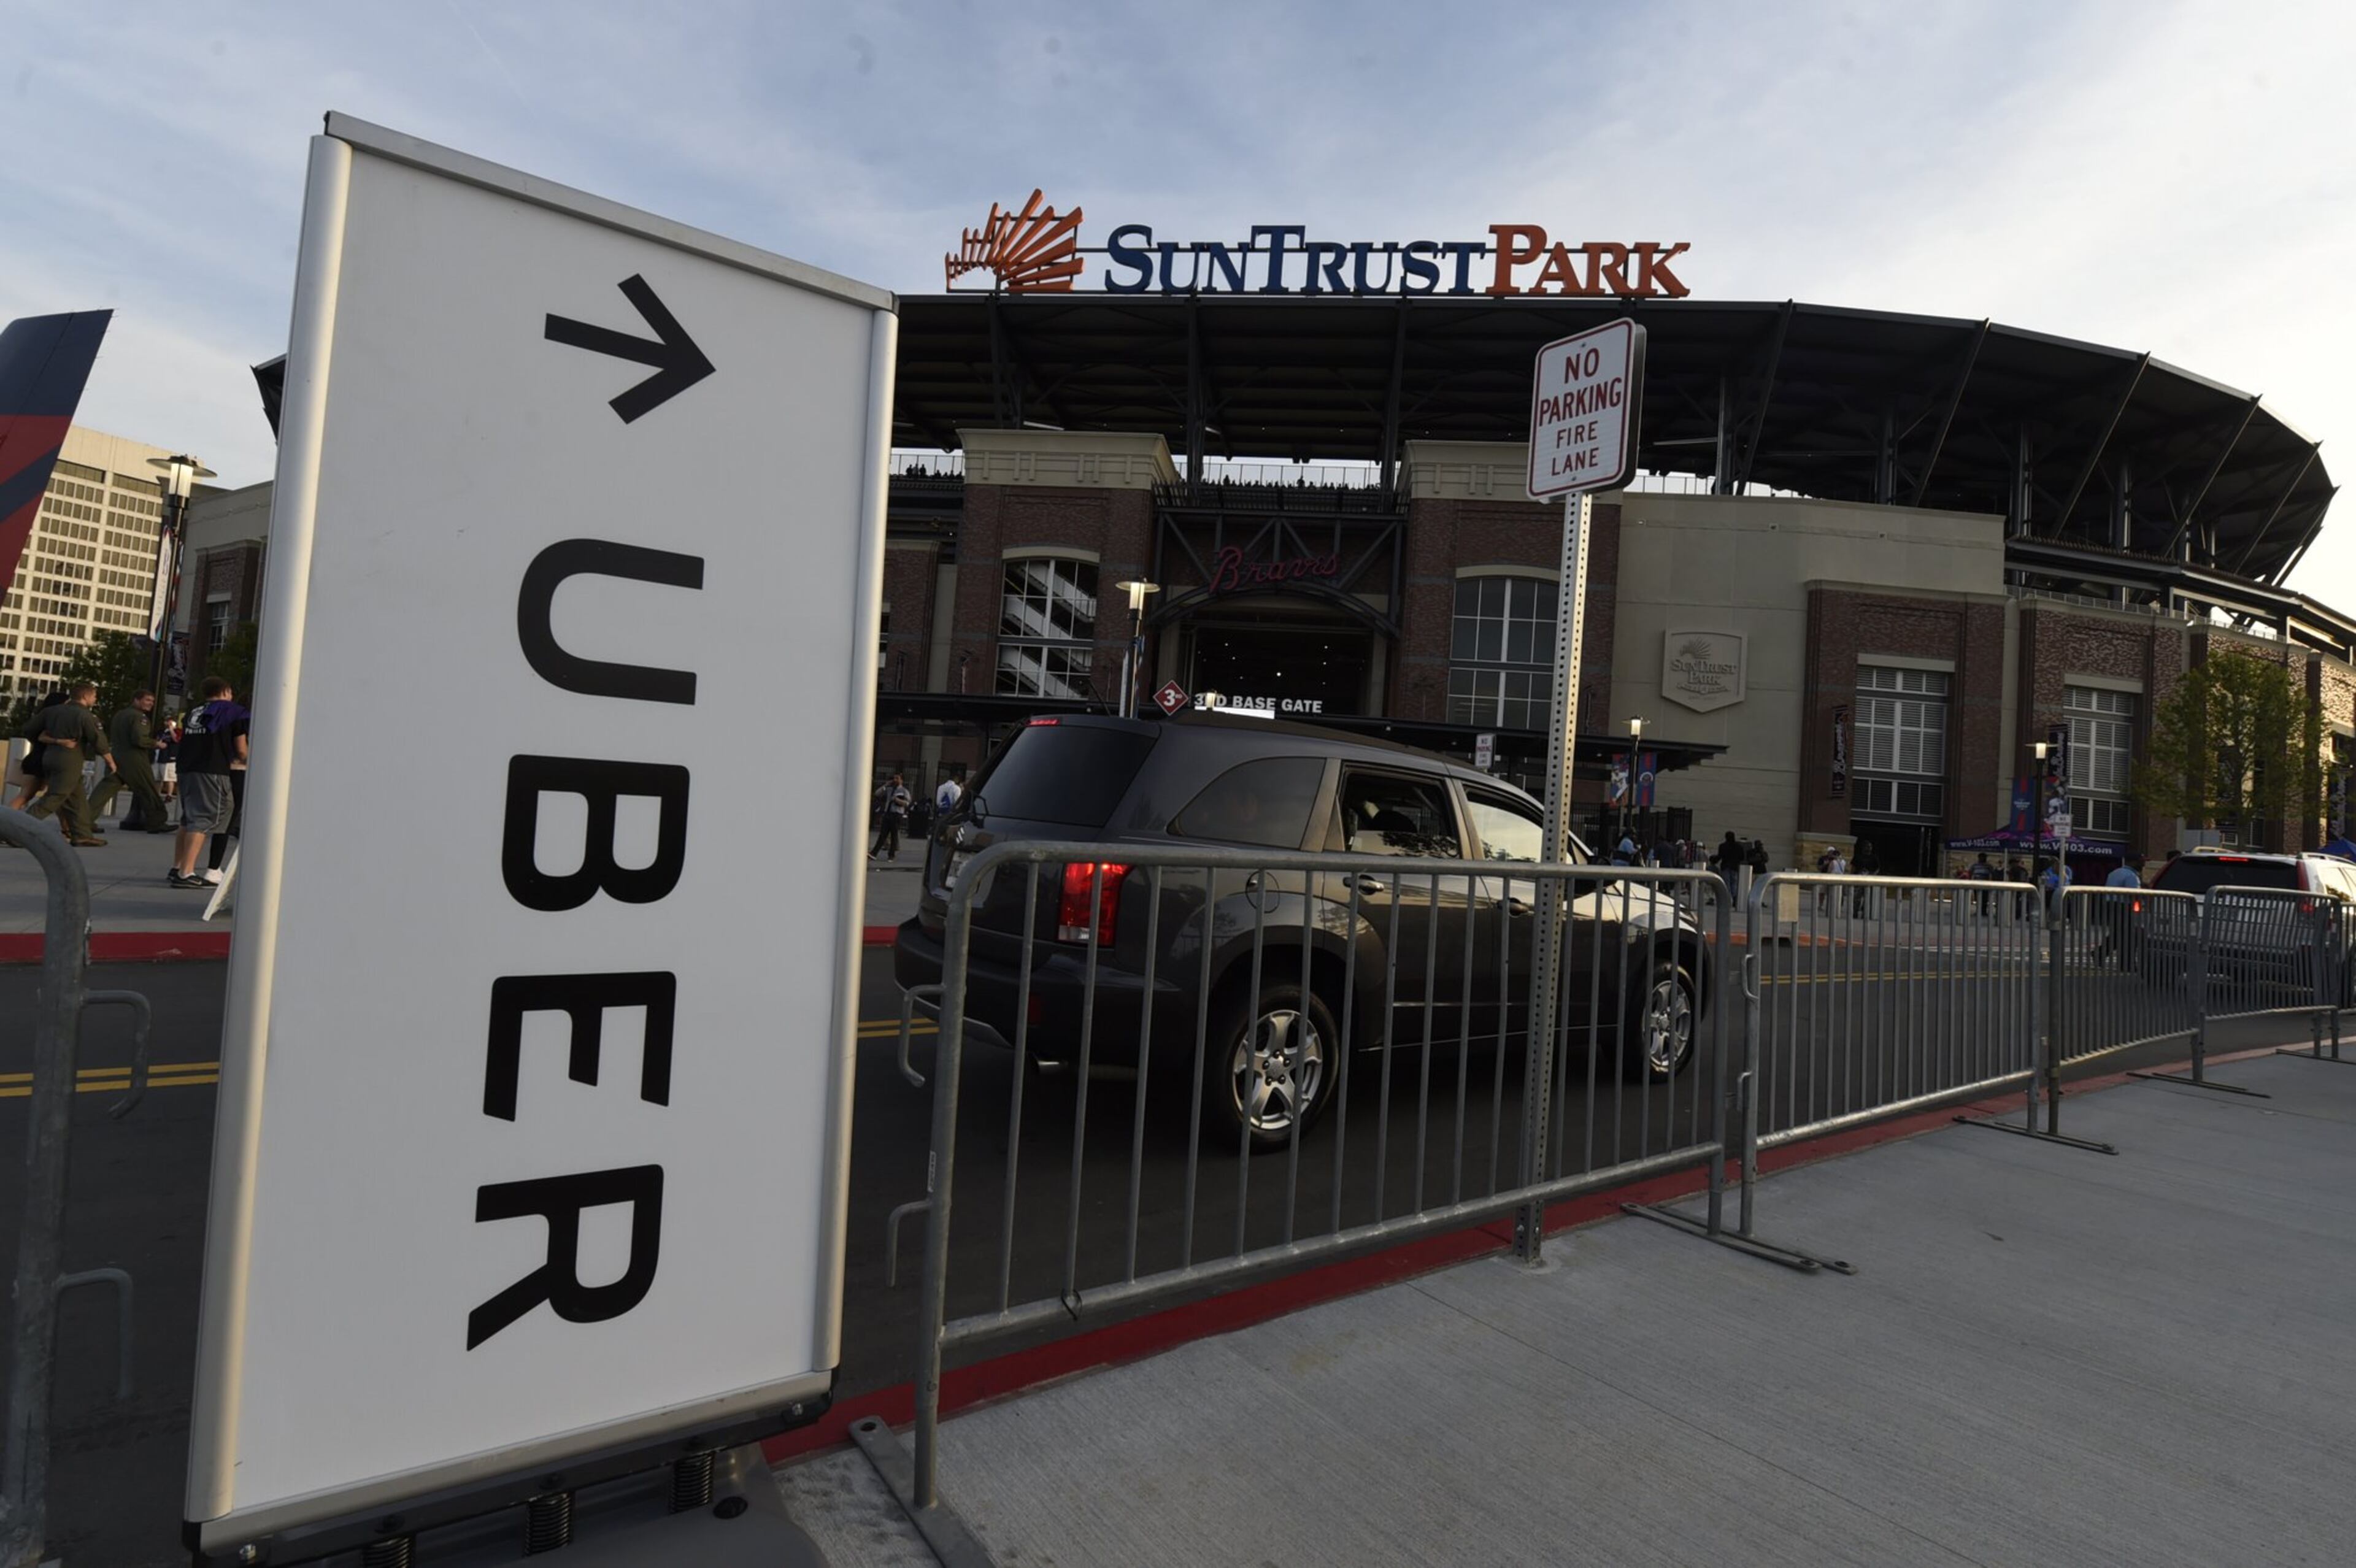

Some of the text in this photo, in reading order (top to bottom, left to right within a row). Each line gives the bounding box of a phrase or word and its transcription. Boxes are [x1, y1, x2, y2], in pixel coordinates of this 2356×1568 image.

[1565, 348, 1600, 384] NO
[1539, 377, 1622, 426] PARKING
[1557, 421, 1598, 449] FIRE
[1552, 448, 1600, 476] LANE
[1208, 546, 1338, 593] Braves
[1195, 693, 1323, 713] 3D BASE GATE
[2019, 841, 2112, 855] ww.V103.com
[467, 539, 704, 1351] UBER
